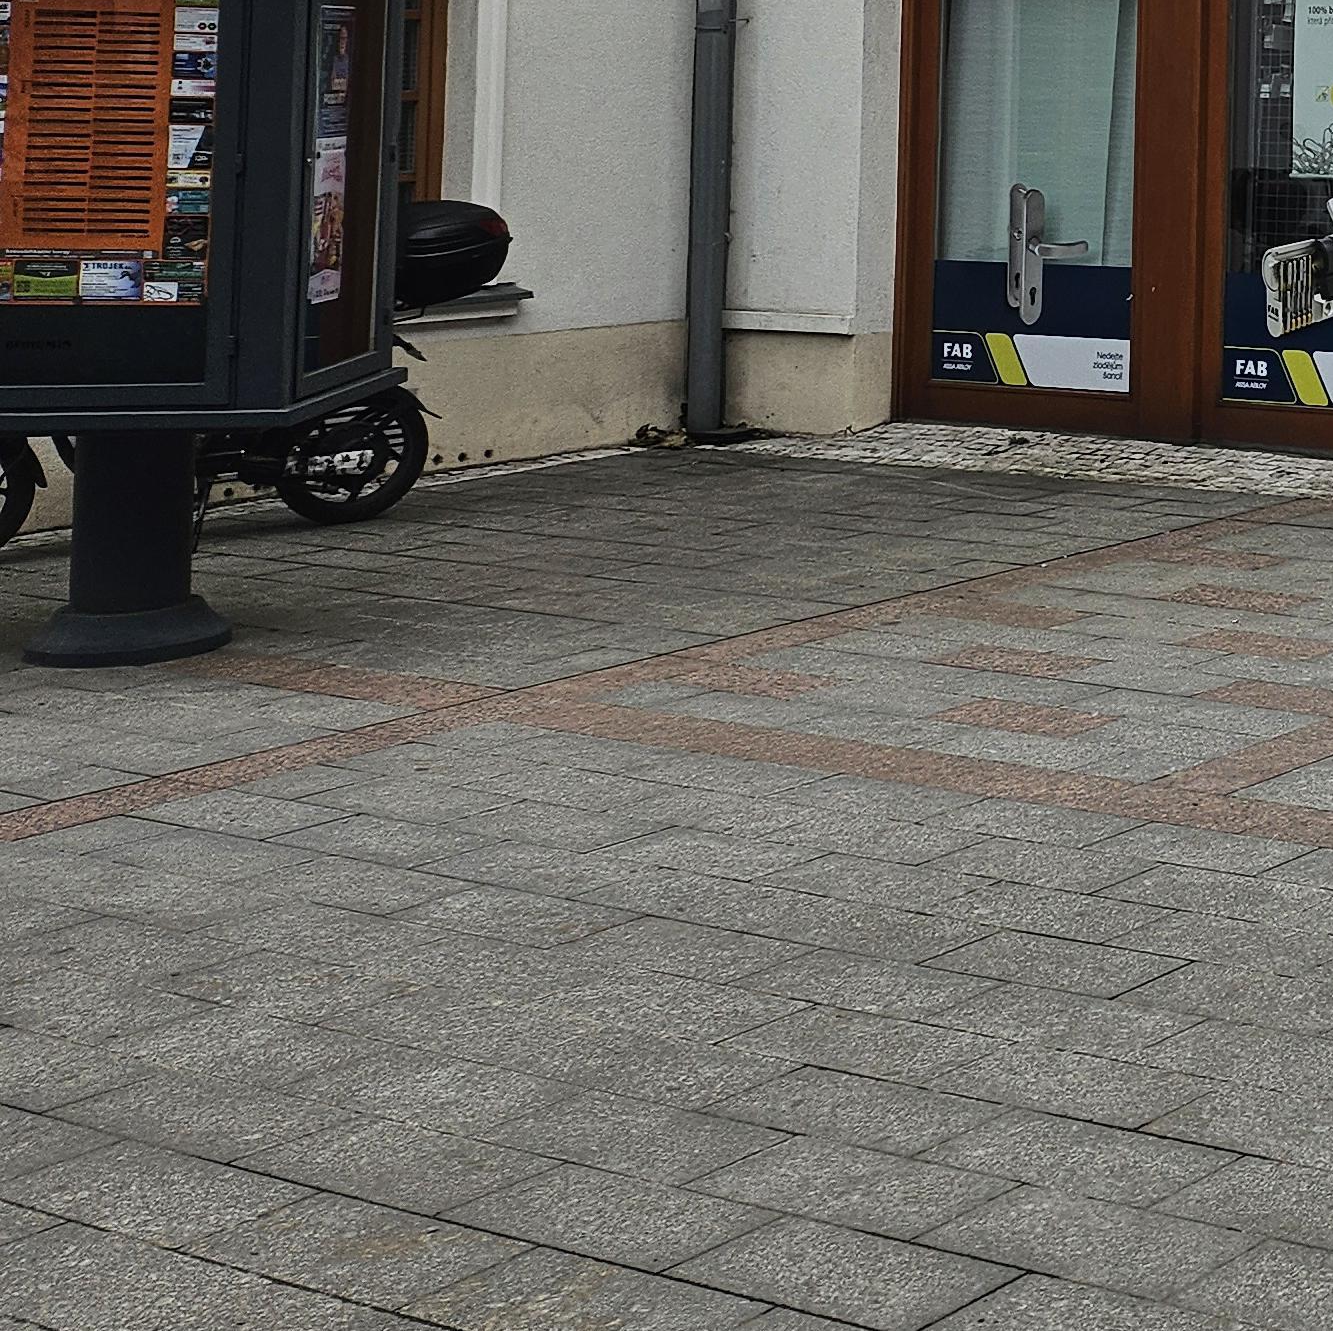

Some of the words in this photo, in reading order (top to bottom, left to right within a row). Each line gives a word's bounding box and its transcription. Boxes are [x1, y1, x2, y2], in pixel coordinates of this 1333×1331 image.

[1308, 6, 1327, 15] 100%
[943, 342, 973, 359] FAB
[1235, 359, 1268, 377] FAB
